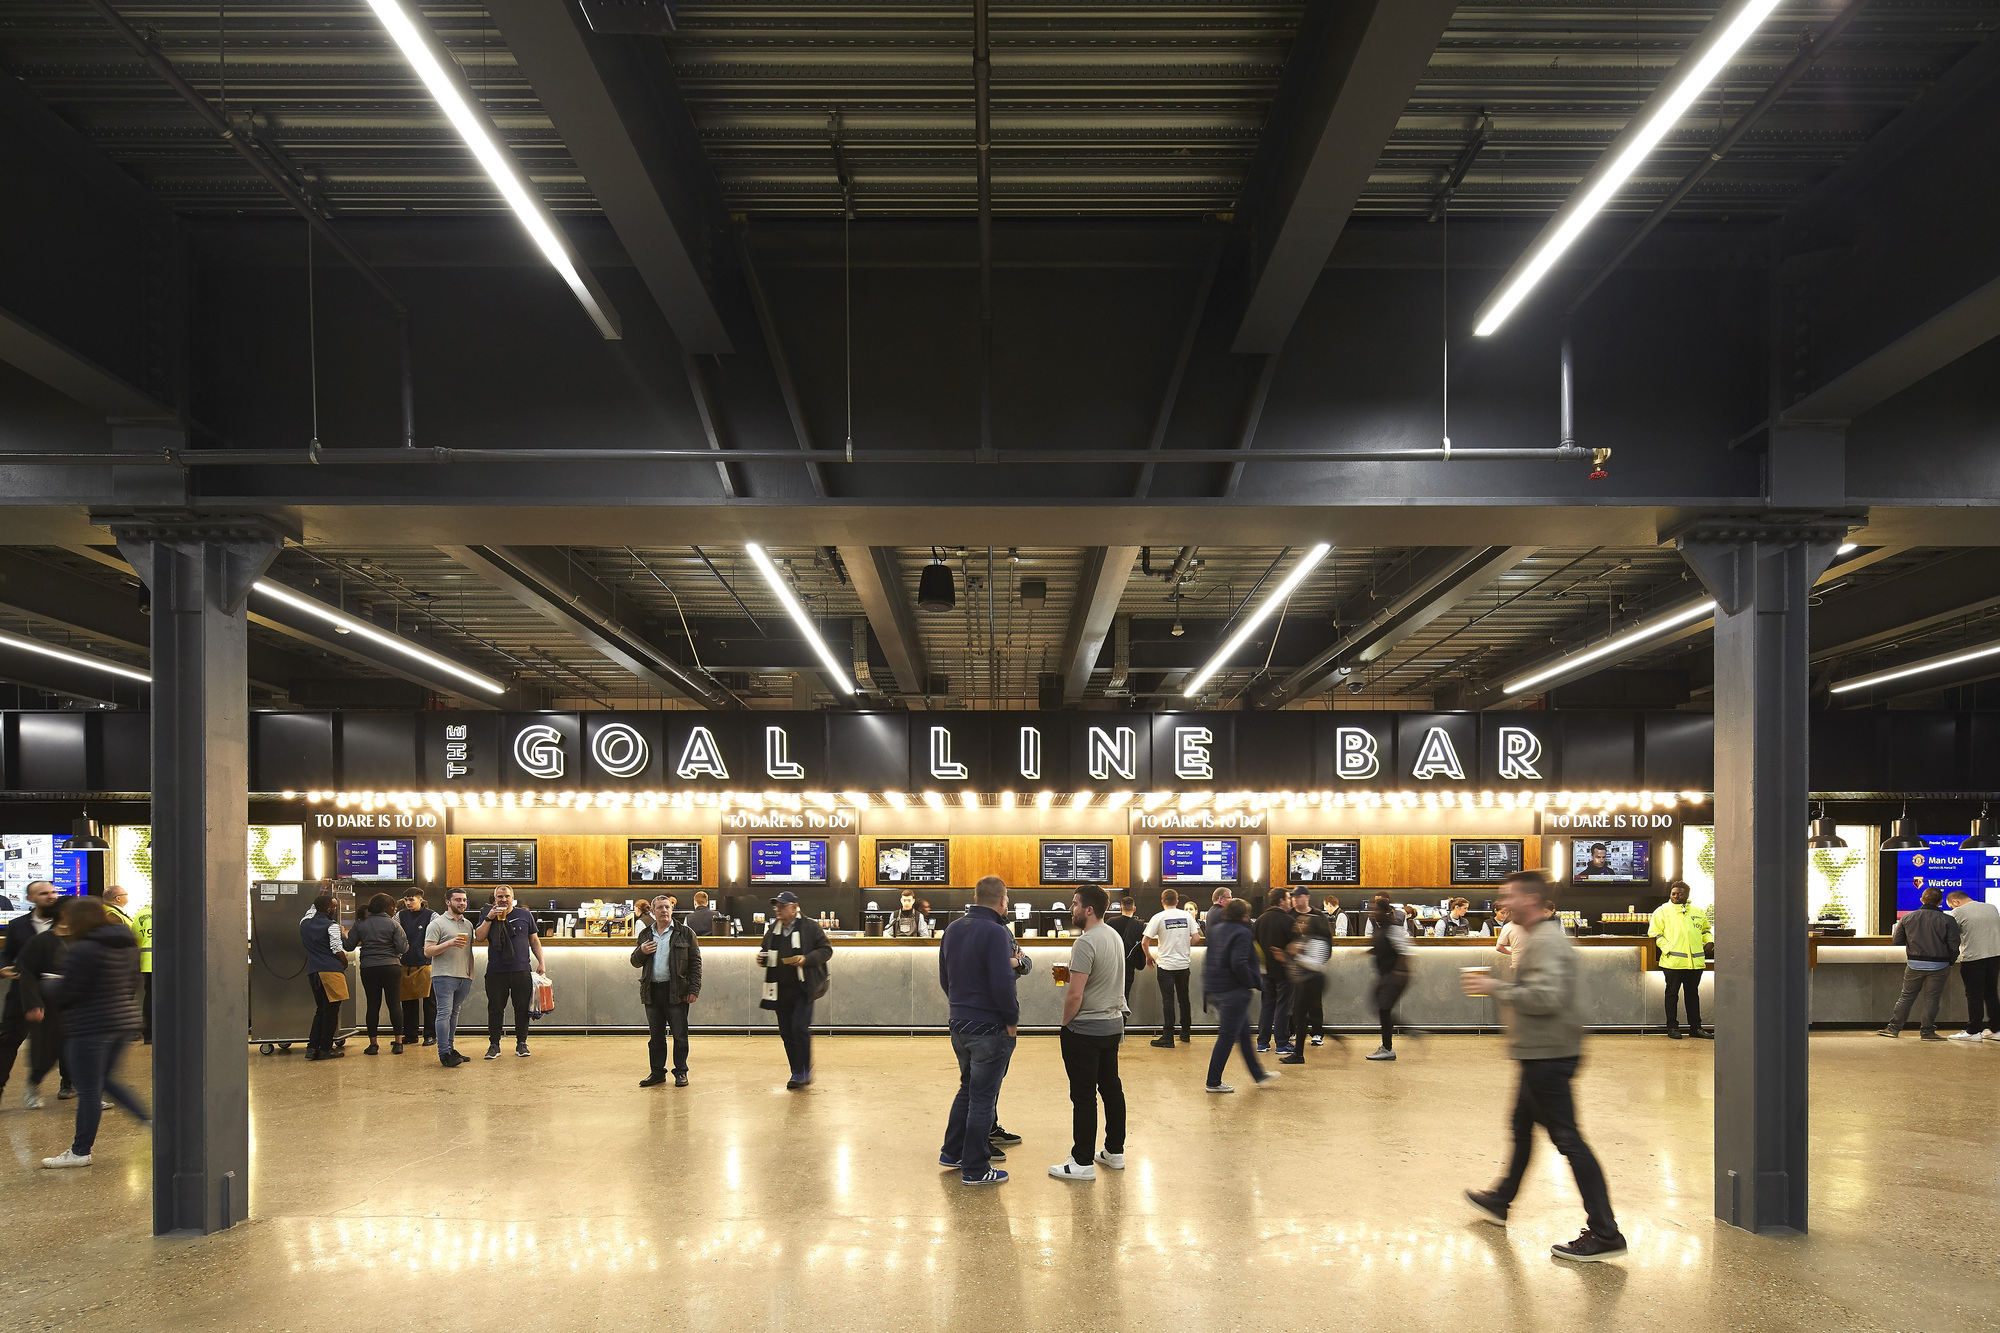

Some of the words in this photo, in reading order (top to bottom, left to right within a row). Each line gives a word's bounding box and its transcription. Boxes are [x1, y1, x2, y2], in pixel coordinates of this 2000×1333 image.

[446, 724, 467, 778] THE
[513, 723, 804, 779] GOAL
[930, 726, 1213, 779] LINE
[1336, 727, 1543, 780] BAR
[315, 814, 334, 828] TO
[338, 814, 375, 828] DARE
[379, 814, 391, 828] IS
[394, 814, 412, 828] TO
[416, 814, 437, 828] DO
[728, 814, 747, 828] TO
[751, 814, 787, 828] DARE
[792, 814, 803, 828] IS
[807, 814, 825, 828] TO
[829, 814, 849, 828] DO
[1141, 814, 1158, 828] TO
[1162, 814, 1199, 828] DARE
[1203, 814, 1214, 828] IS
[1218, 814, 1236, 828] TO
[1240, 814, 1260, 828] DO
[1552, 814, 1570, 828] TO
[1574, 814, 1610, 828] DARE
[1614, 814, 1626, 828] IS
[1630, 814, 1648, 828] TO
[1652, 814, 1672, 828] DO
